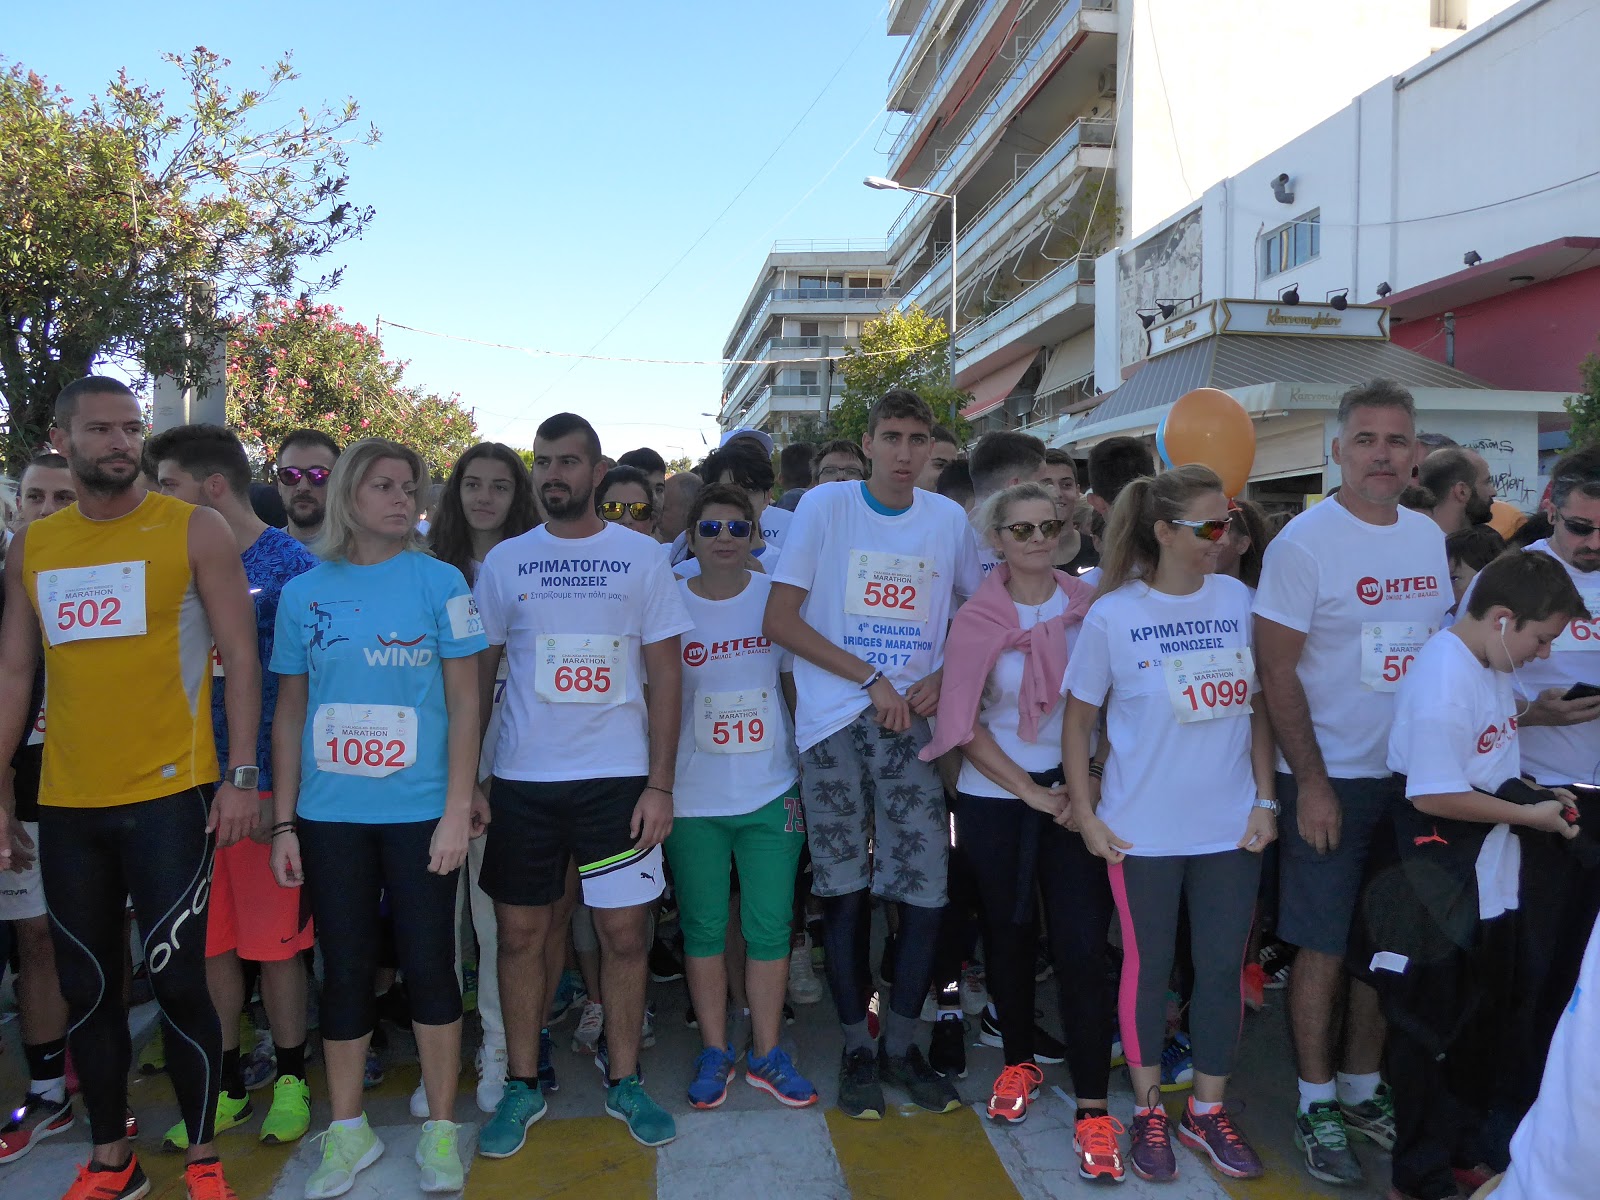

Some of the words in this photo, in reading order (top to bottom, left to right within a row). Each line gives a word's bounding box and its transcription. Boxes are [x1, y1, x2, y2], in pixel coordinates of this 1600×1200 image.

[518, 559, 632, 576] ΚΡΙΜΑΤΟΓΛΟΥ
[541, 576, 608, 587] ΜΟΝΩΣΕΙΣ
[873, 574, 912, 584] MARATHON
[65, 588, 114, 600] MARATHON
[573, 592, 587, 600] την
[588, 590, 607, 600] πόλη
[863, 581, 916, 611] 582
[57, 596, 122, 631] 502
[872, 624, 921, 637] CHALKIDA
[1130, 619, 1239, 642] ΚΡΙΜΑΤΟΓΛΟΥ
[843, 635, 882, 648] BRIDGES
[885, 639, 933, 651] MARATHON
[1160, 637, 1225, 653] ΜΟΝΩΣΕΙΣ
[363, 647, 433, 667] WIND
[562, 657, 606, 665] MARATHON
[866, 651, 912, 666] 2017
[554, 665, 611, 693] 685
[1194, 671, 1234, 682] MARATHON
[1182, 678, 1248, 711] 1099
[719, 710, 758, 720] MARATHON
[341, 729, 388, 737] MARATHON
[712, 718, 764, 745] 519
[326, 736, 406, 767] 1082
